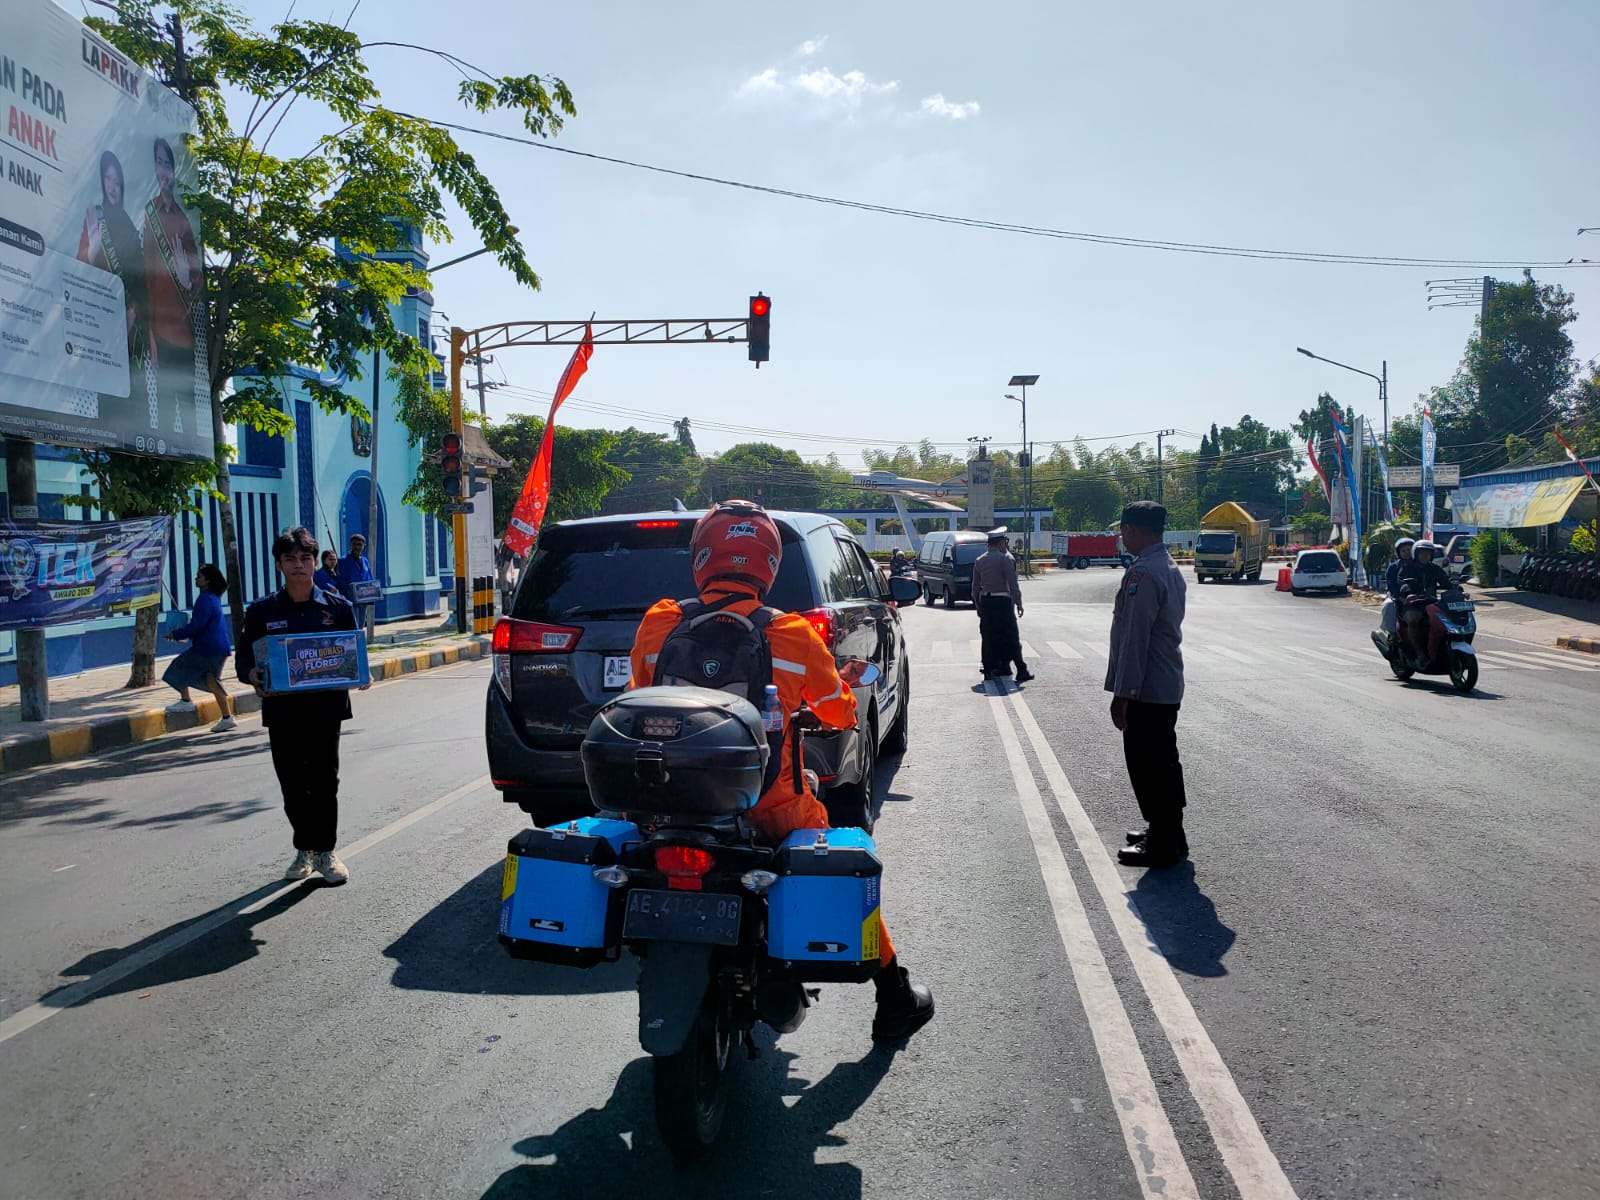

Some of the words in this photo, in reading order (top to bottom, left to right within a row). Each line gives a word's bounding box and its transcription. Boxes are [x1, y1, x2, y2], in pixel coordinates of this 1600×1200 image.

[82, 37, 140, 99] LAPAKK
[22, 66, 67, 124] PADA
[8, 104, 58, 161] ANAK
[9, 160, 43, 197] ANAK
[20, 232, 43, 252] Kami
[732, 556, 747, 564] DOT
[53, 589, 76, 599] AWARD
[300, 649, 318, 659] OPEN
[305, 659, 338, 670] FLORES
[523, 663, 558, 672] INNOVA
[606, 659, 629, 676] AE
[629, 894, 652, 912] AE
